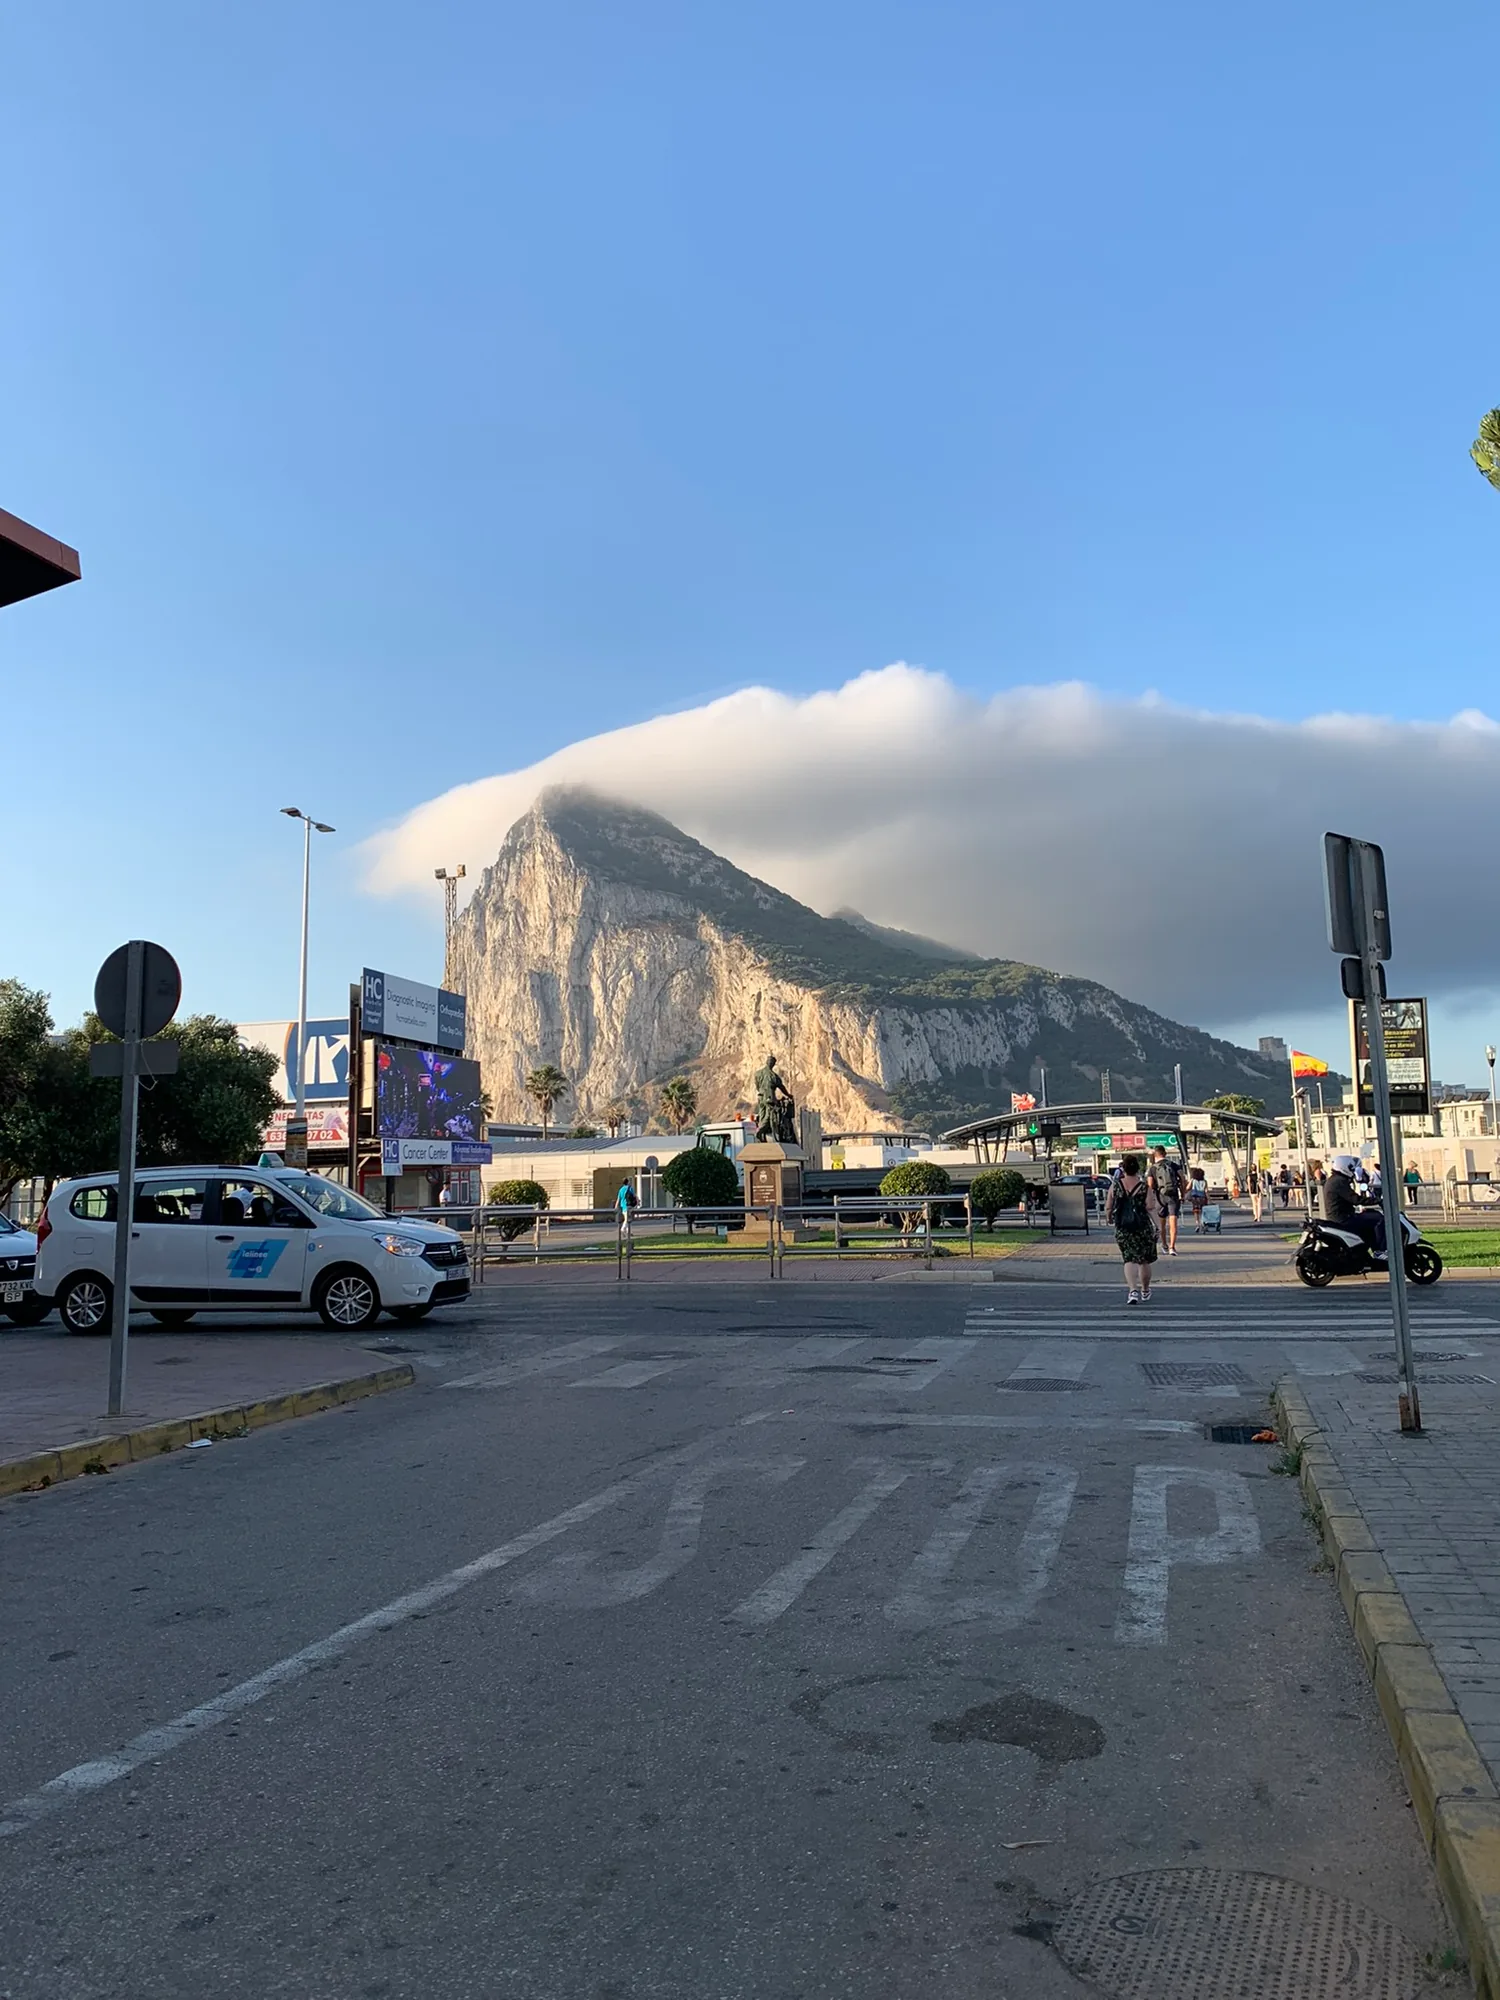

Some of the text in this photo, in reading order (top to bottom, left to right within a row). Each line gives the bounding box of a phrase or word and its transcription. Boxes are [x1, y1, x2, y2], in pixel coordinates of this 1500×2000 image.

[365, 975, 382, 1000] HC
[387, 989, 436, 1015] Diagnostic Imaging
[319, 1129, 333, 1140] 02
[384, 1140, 397, 1158] HC
[403, 1145, 449, 1160] Cancer Center
[6, 1292, 21, 1302] SP
[510, 1454, 1263, 1648] STOP
